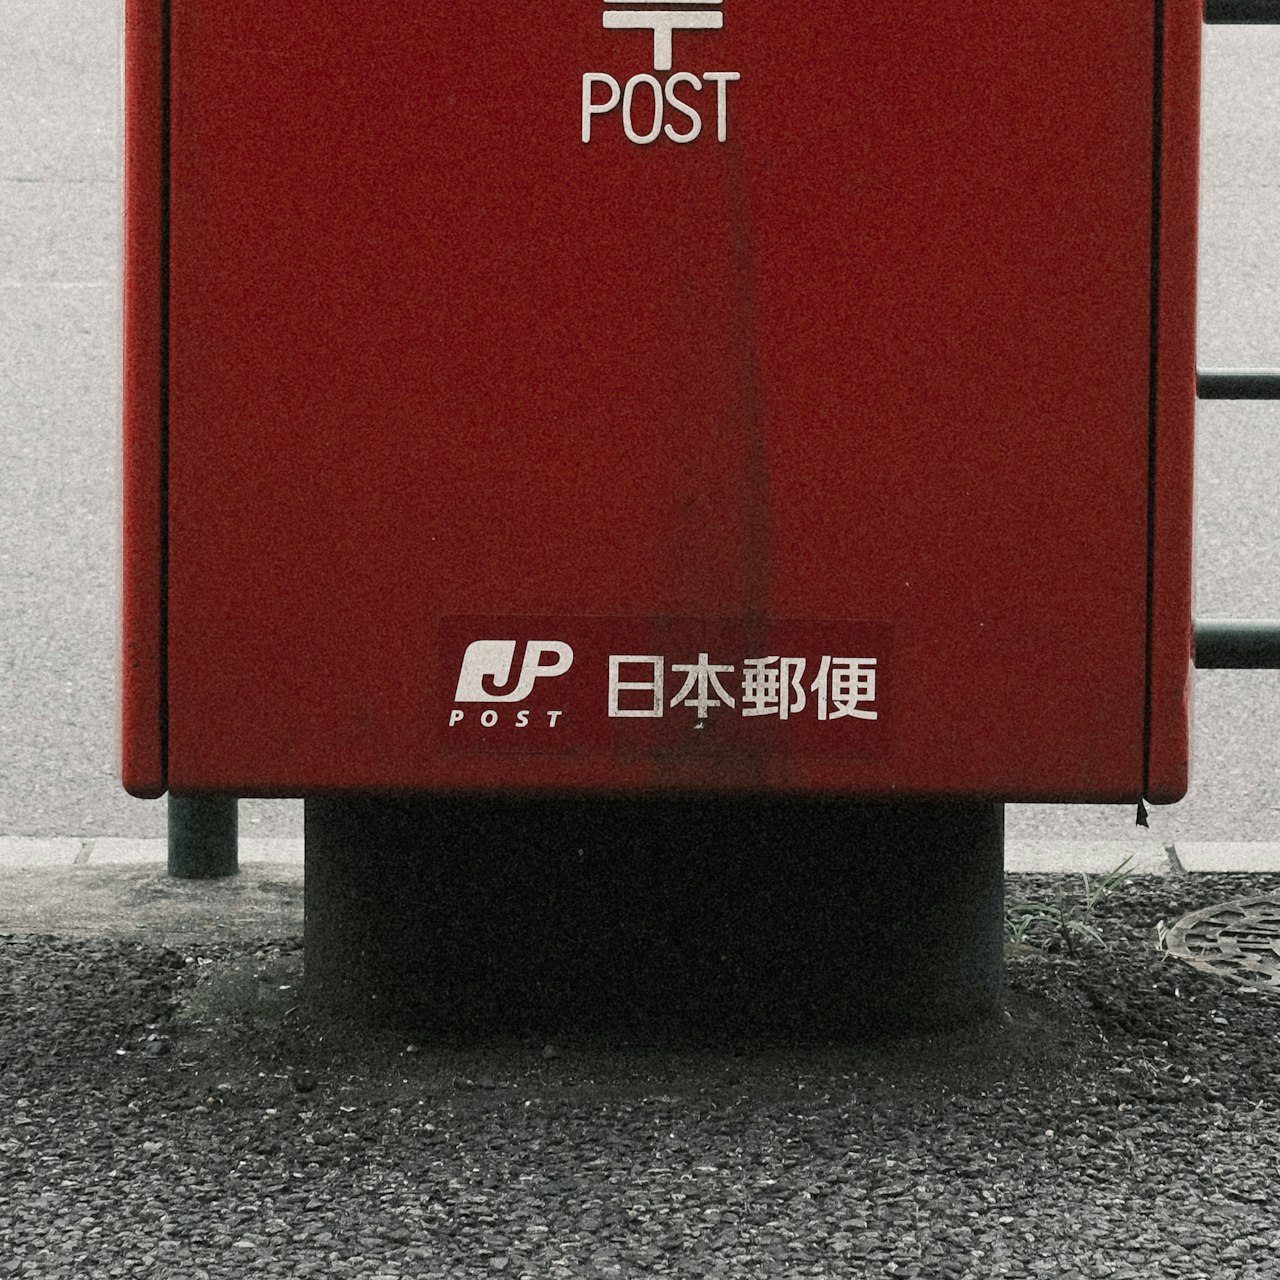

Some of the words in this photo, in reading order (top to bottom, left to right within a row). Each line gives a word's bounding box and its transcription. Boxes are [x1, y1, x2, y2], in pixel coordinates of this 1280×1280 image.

[582, 71, 741, 144] POST
[449, 709, 562, 727] POST
[608, 652, 878, 720] 日本郵便
